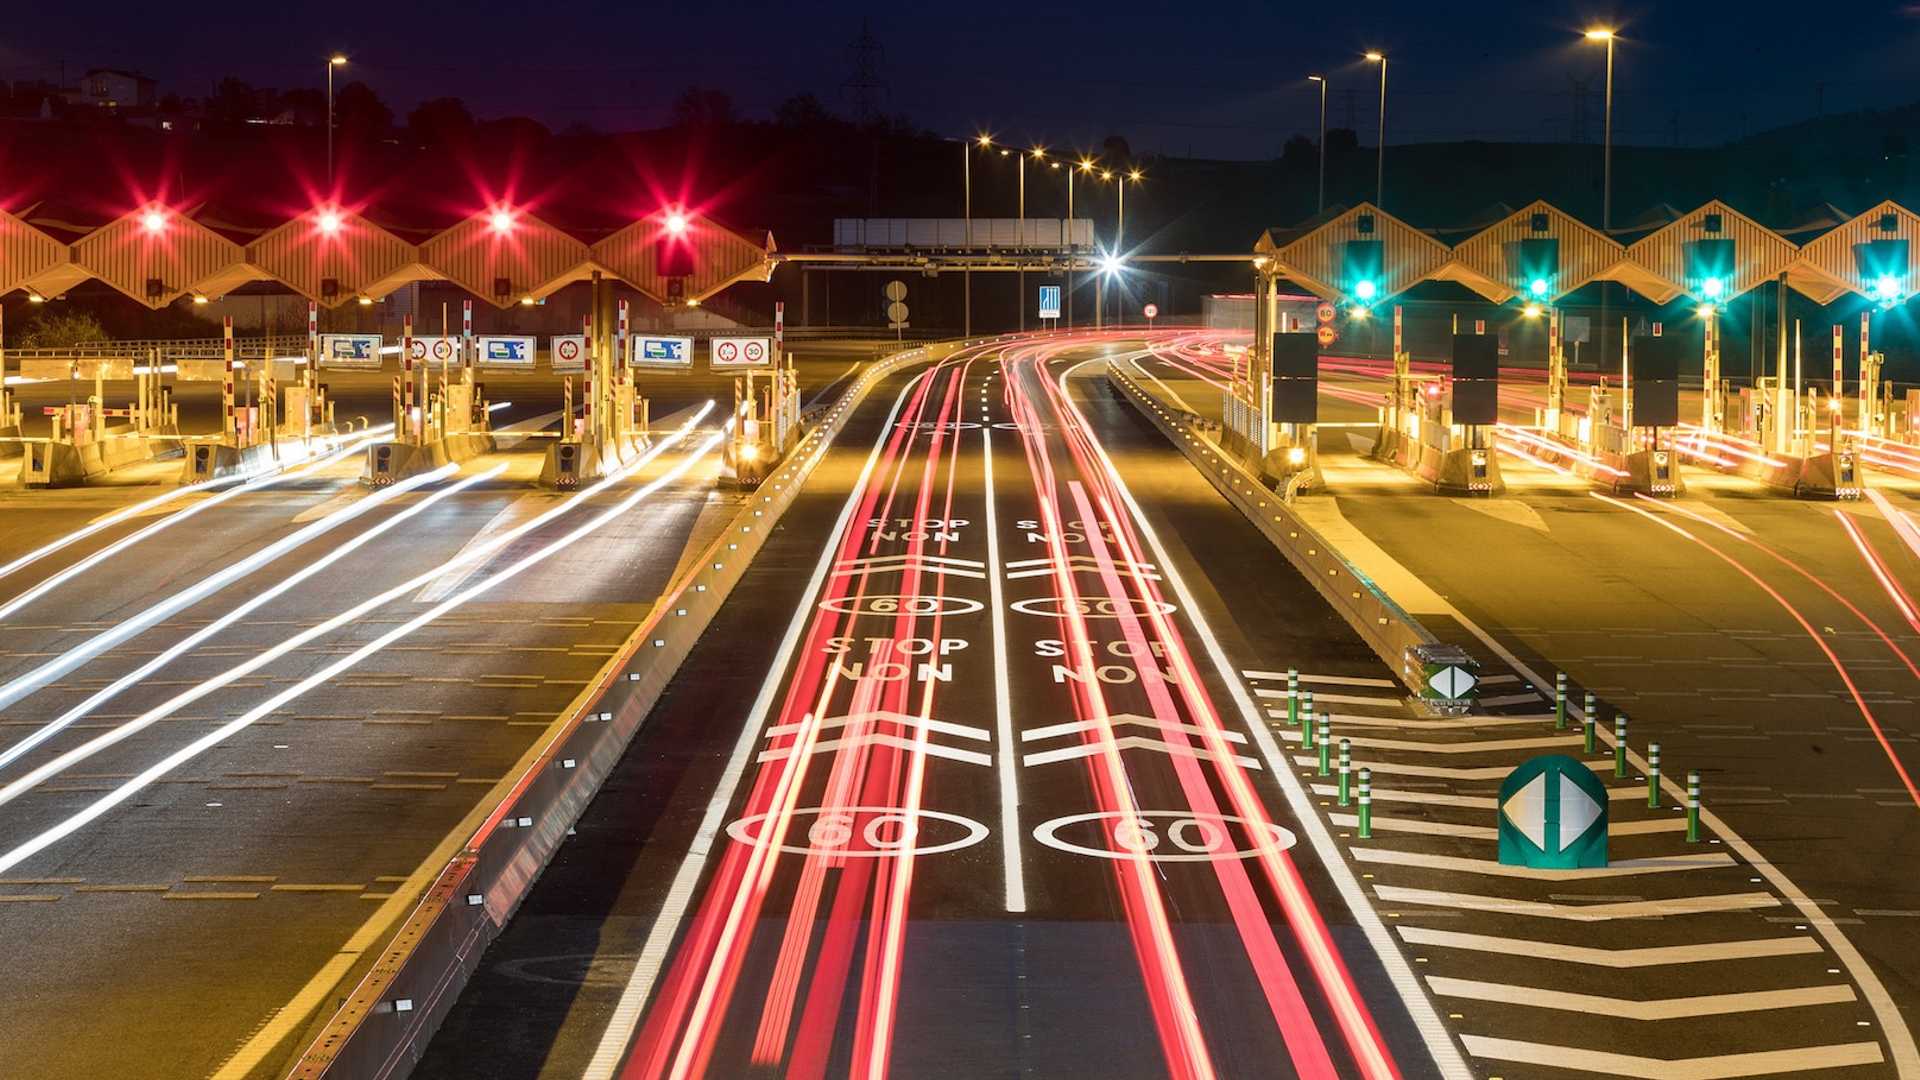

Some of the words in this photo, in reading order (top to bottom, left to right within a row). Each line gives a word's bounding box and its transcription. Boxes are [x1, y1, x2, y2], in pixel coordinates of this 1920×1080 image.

[866, 518, 970, 529] STOP
[871, 531, 960, 542] NON
[870, 598, 939, 613] 60
[821, 637, 969, 656] STOP
[825, 662, 953, 682] NON
[808, 815, 919, 849] 60
[1114, 818, 1224, 852] 60
